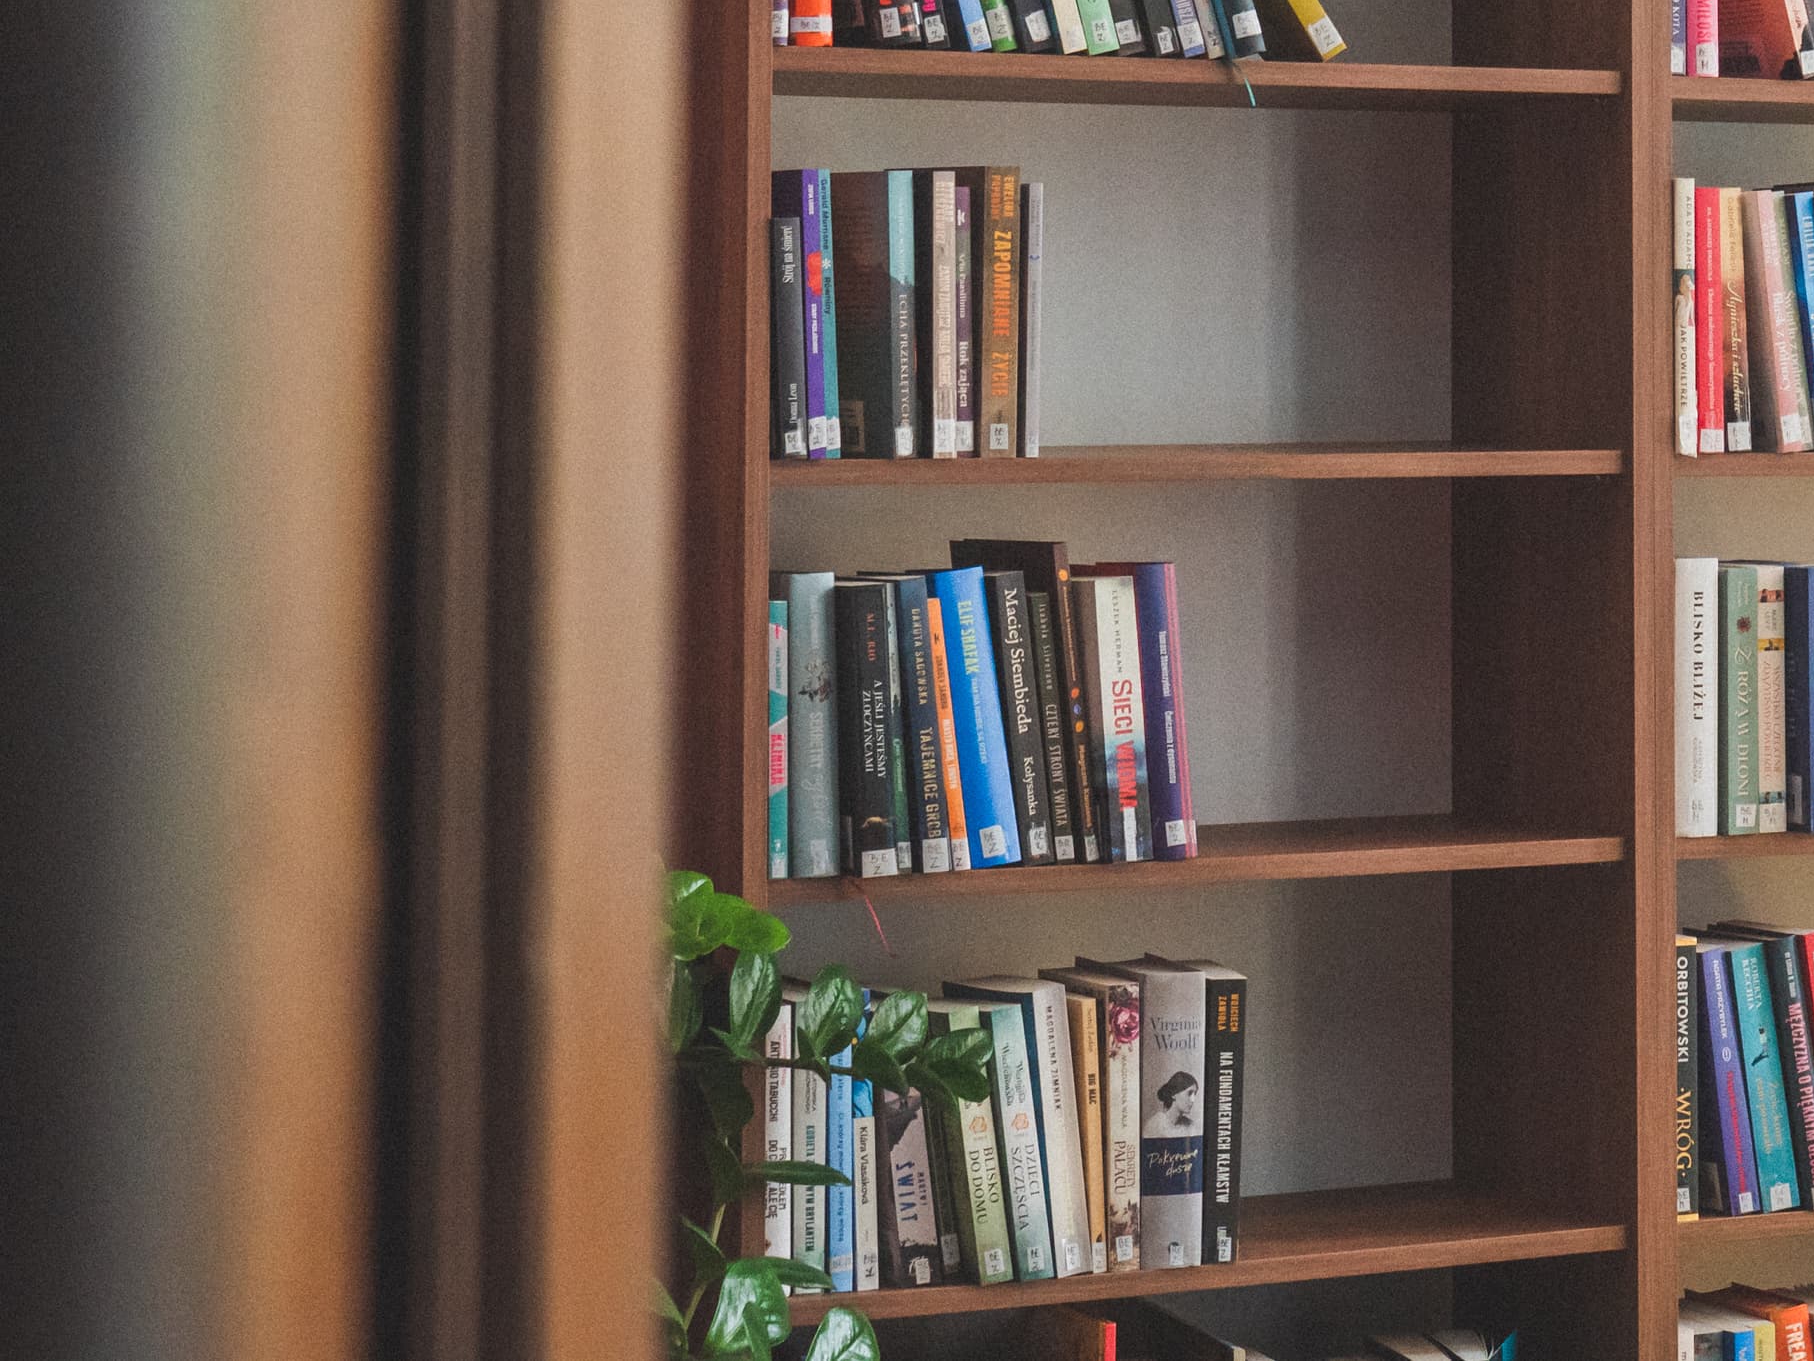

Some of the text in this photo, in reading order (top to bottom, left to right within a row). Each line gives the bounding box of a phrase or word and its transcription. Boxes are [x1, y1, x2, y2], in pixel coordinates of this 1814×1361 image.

[1672, 6, 1680, 36] KOTA
[991, 230, 1012, 397] ZAPOMNIANE ŻYCIE
[1773, 291, 1785, 330] Blask
[897, 294, 911, 423] ECHA PRZEKLĘTYCH
[957, 341, 970, 408] Rok zająca
[1680, 346, 1688, 408] POWIETRZE
[911, 608, 928, 706] DANUTA SADOWSKA
[957, 600, 978, 675] ELIF SHAFAK
[1692, 591, 1707, 721] BLISKO BLIŻEJ
[862, 690, 875, 773] ZŁOCZYŃCAMI
[873, 679, 887, 779] A JEŚLI JESTEŚMY
[1004, 588, 1039, 816] Maciej Siembieda Kołysanka
[1733, 646, 1752, 797] Z RÓŻĄ W DŁONI
[808, 711, 825, 769] SEKRETNY
[919, 727, 938, 800] TAJEMNICE
[1045, 704, 1068, 827] CZTERY STRONY ŚWIATA
[1115, 739, 1138, 811] WIDMA
[1677, 956, 1689, 1063] ORBITOWSKI
[1711, 959, 1722, 991] AGATA
[1741, 959, 1755, 1011] RECCHIA
[1750, 957, 1762, 1009] ROBERTA
[1154, 1033, 1199, 1051] Woolf
[1230, 993, 1240, 1033] WOJCIECH
[1784, 1002, 1806, 1073] MĘŻCZYZNA
[1045, 1005, 1061, 1111] MAGDALENA ZIMNIAK
[769, 1080, 778, 1122] TABUCCHI
[1215, 1051, 1233, 1204] NA FUNDAMENTACH KŁAMSTW
[768, 1187, 778, 1203] ALE
[859, 1126, 870, 1205] Klára Vlasáková
[895, 1162, 918, 1222] ŚWIAT
[968, 1150, 988, 1225] DO DOMU
[982, 1146, 1001, 1204] BLISKO
[1009, 1146, 1029, 1231] SZCZĘŚCIA
[1023, 1143, 1041, 1197] DZIECI
[1114, 1141, 1127, 1195] PAŁACU
[1126, 1144, 1136, 1189] SEKRETY
[805, 1206, 815, 1252] BRYLANTEM
